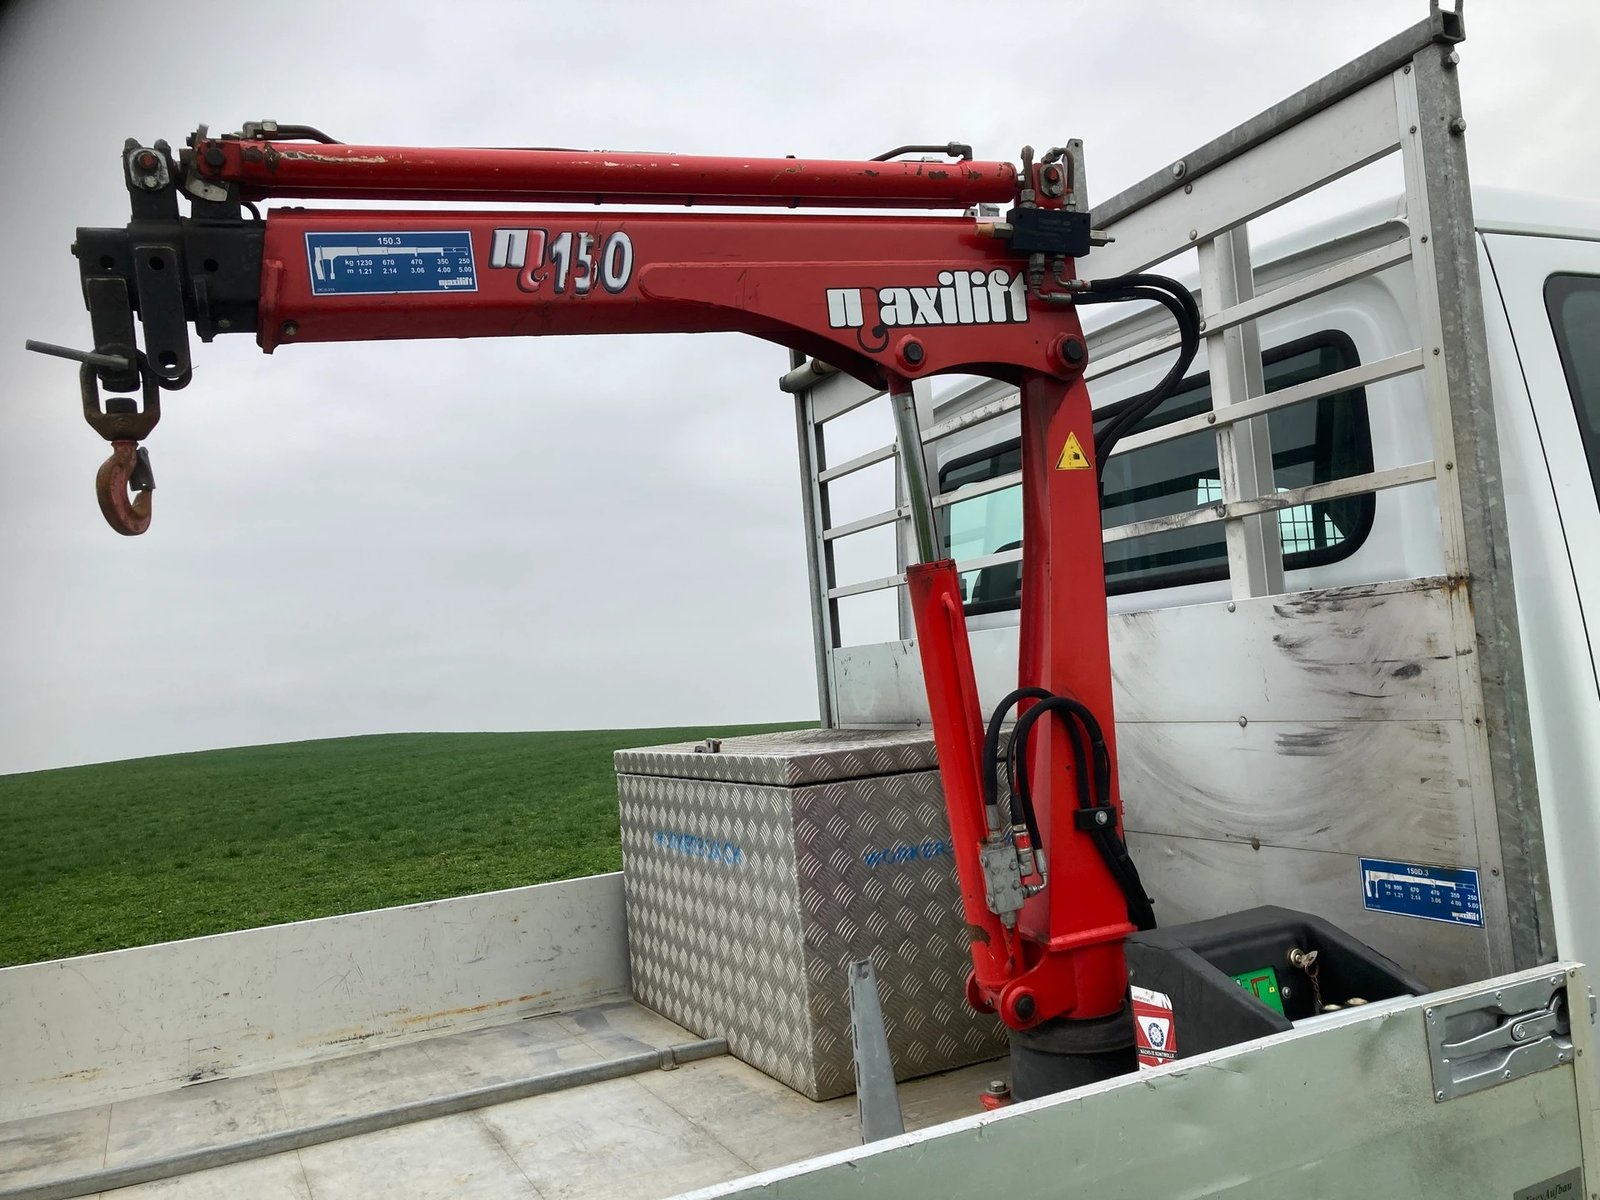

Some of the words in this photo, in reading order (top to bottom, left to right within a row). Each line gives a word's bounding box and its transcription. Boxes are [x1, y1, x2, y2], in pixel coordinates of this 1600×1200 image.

[377, 237, 401, 245] 150.3
[345, 259, 354, 267] kg
[438, 277, 473, 289] maxilift
[826, 269, 1029, 353] maxilift
